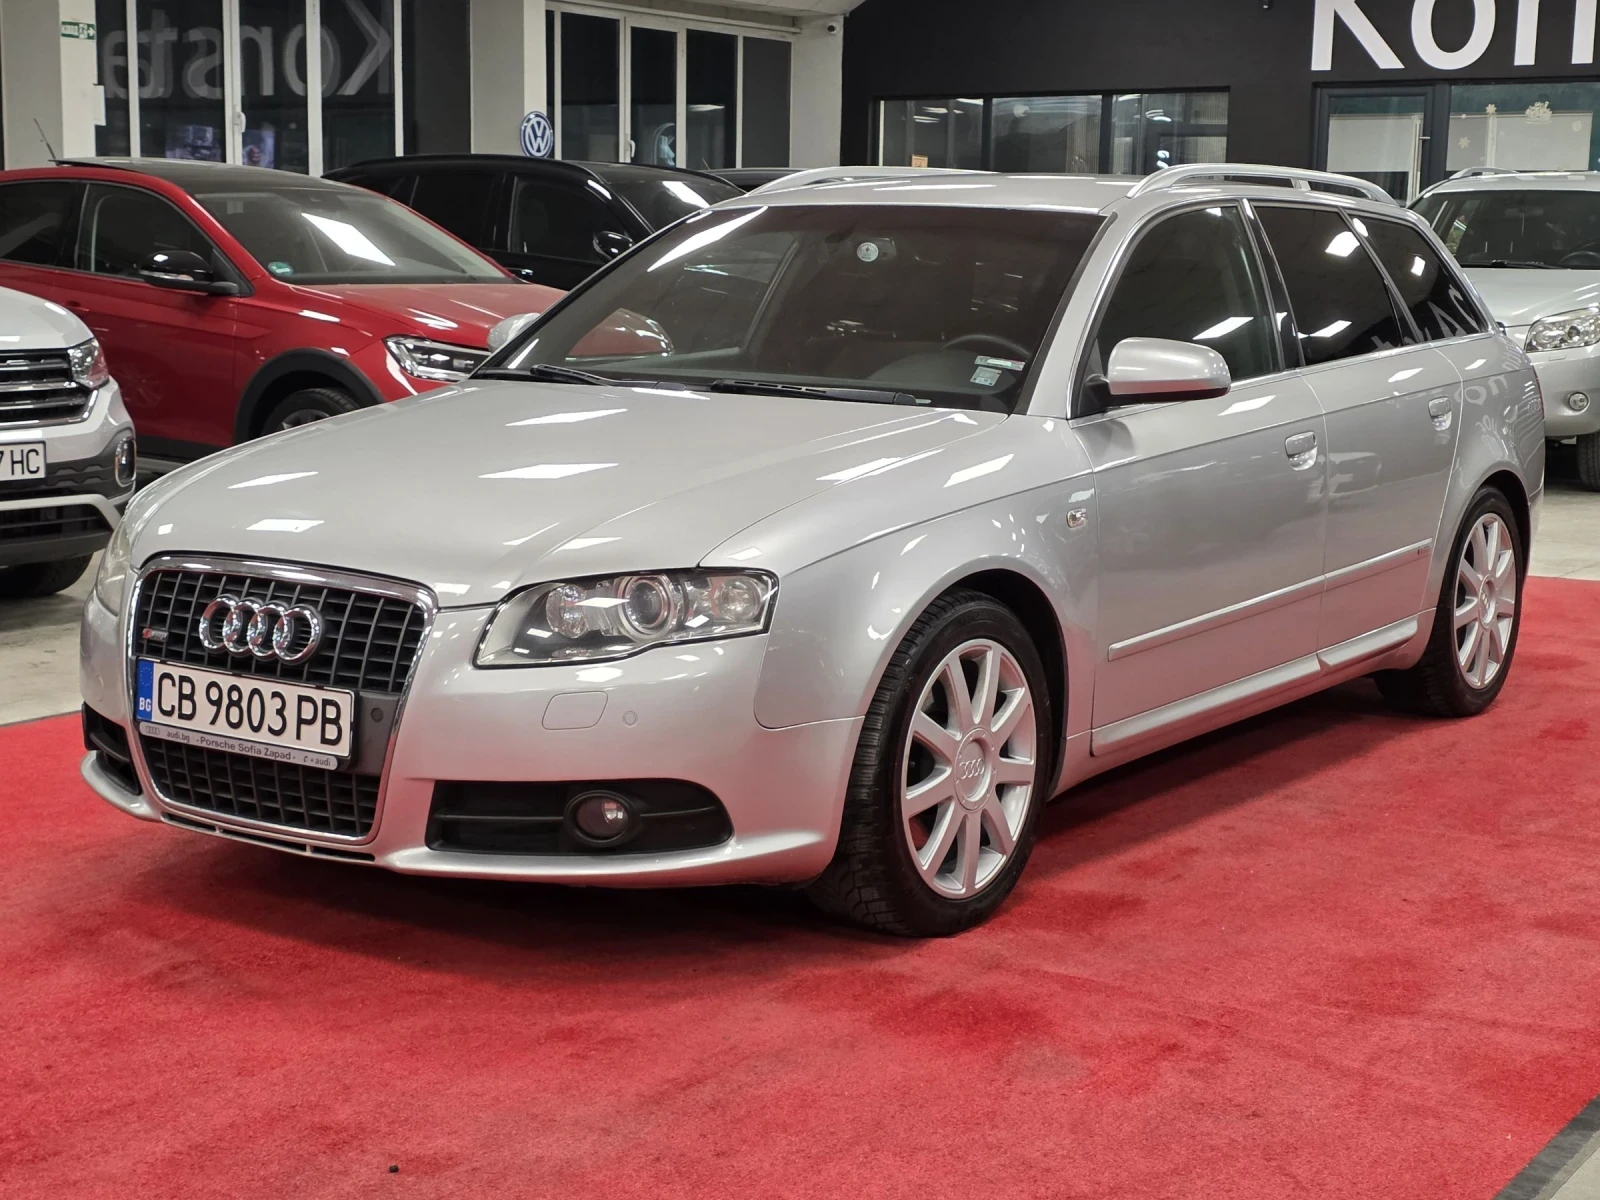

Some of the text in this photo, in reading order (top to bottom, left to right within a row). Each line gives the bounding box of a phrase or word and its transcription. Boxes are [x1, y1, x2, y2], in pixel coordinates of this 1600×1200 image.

[10, 448, 40, 475] HC
[139, 697, 152, 712] BG
[158, 672, 343, 747] CB 9803 PB
[166, 730, 191, 744] audi.bg
[238, 743, 262, 755] Sofia
